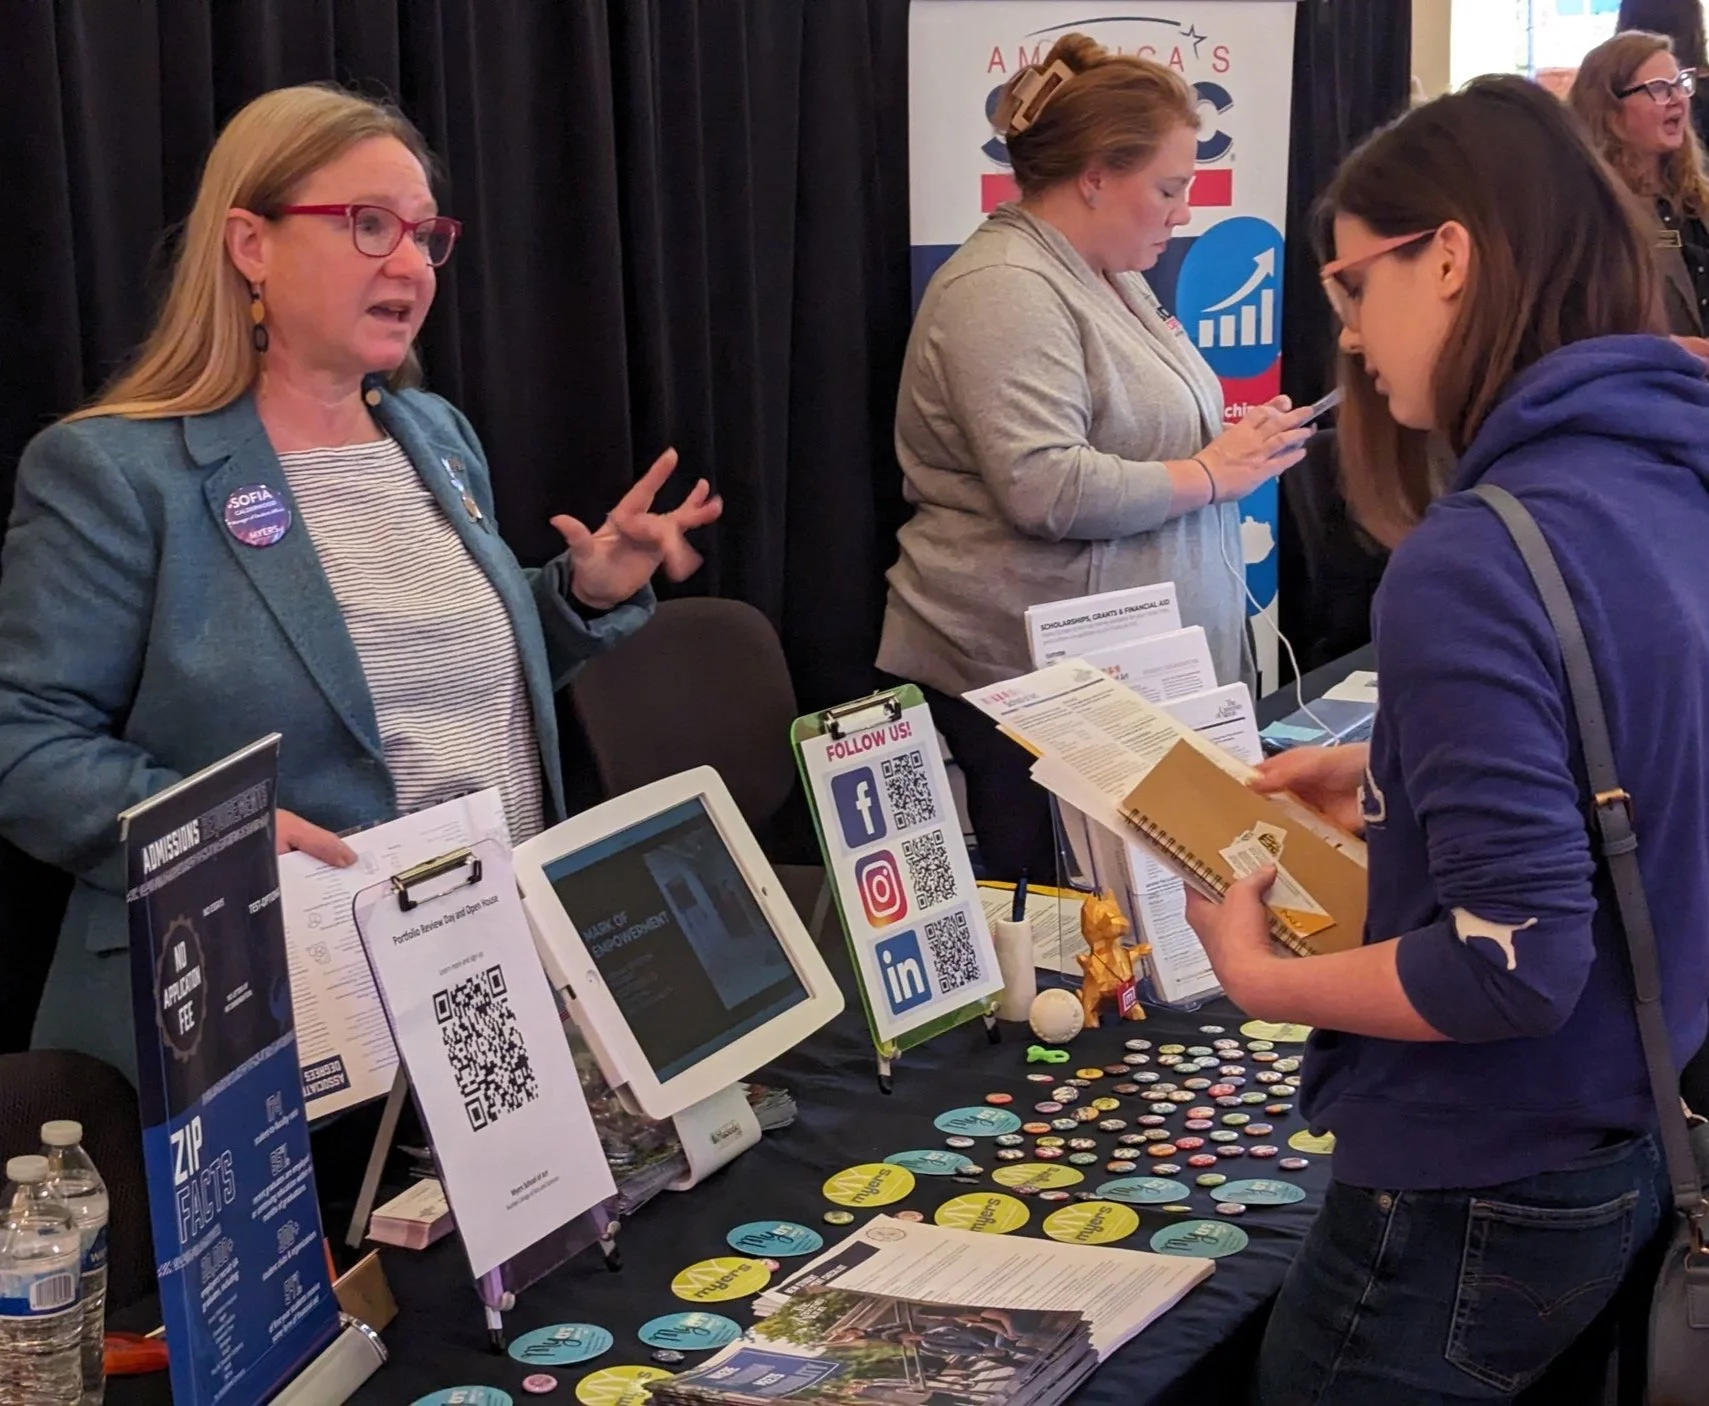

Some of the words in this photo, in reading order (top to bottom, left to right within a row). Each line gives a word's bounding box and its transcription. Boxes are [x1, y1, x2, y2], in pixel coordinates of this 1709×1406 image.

[230, 490, 273, 508] SOFIA
[1040, 615, 1091, 631] SCHOLARSHIPS,
[1092, 609, 1118, 621] GRANTS
[1124, 601, 1158, 616] FINANCIAL
[1159, 599, 1170, 607] AID
[826, 728, 886, 763] FOLLOW
[891, 721, 913, 742] US!
[142, 818, 200, 875] ADMISSIONS
[392, 927, 420, 945] Portfolio
[420, 919, 443, 934] Review
[443, 914, 456, 925] Day
[456, 908, 465, 919] and
[465, 903, 481, 915] Open
[482, 896, 499, 907] House
[582, 919, 616, 941] MARK
[613, 910, 627, 928] OF
[592, 910, 670, 958] EMPOWERMENT
[174, 940, 187, 974] NO
[164, 965, 201, 1010] APPLICATION
[881, 949, 926, 1004] in
[178, 1000, 195, 1035] FEE
[304, 1060, 341, 1082] DEGREES
[170, 1115, 203, 1187] ZIP
[175, 1149, 236, 1245] FACTS
[851, 1168, 892, 1204] myers
[970, 1197, 1001, 1232] myers
[1075, 1205, 1113, 1242] myers
[695, 1263, 753, 1298] myers
